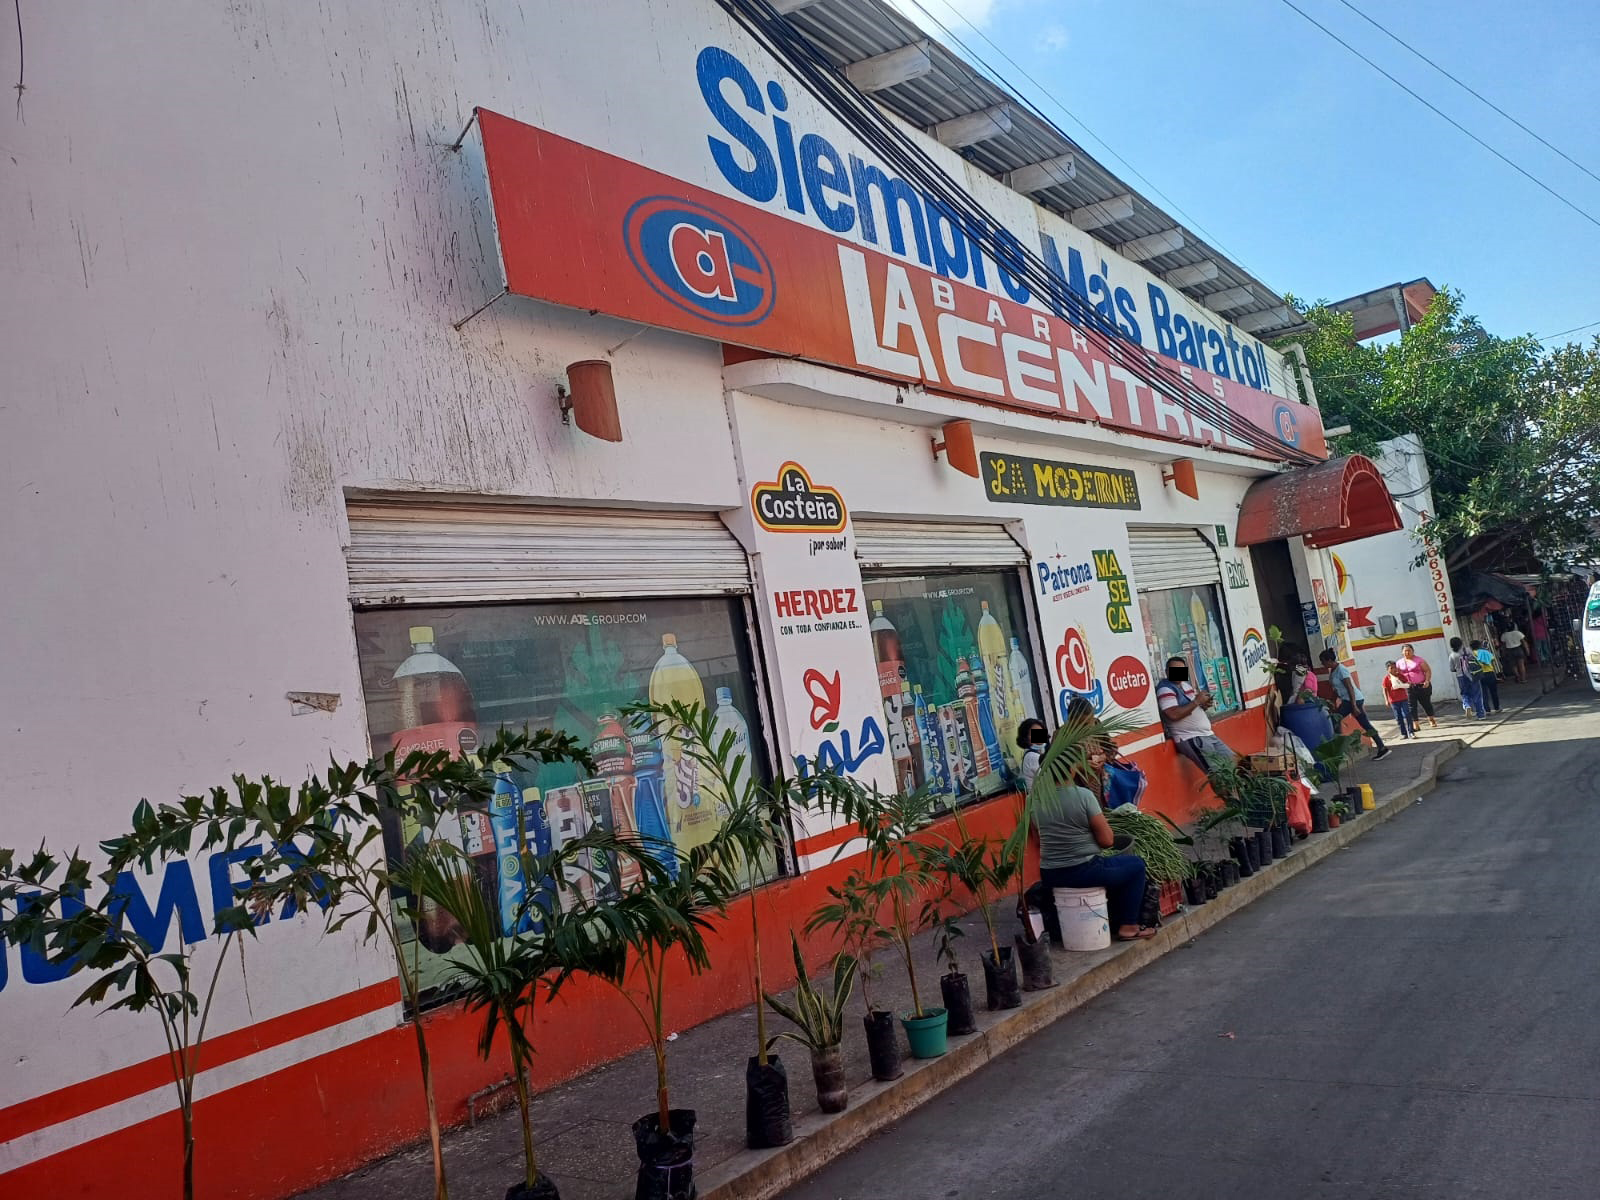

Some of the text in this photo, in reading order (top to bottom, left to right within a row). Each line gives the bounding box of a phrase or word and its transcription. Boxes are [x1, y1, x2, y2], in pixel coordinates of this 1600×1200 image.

[697, 46, 1031, 304] Siempre
[837, 243, 940, 384] LA
[786, 473, 805, 493] La
[761, 493, 838, 520] Costeña
[1036, 562, 1093, 595] Patrona
[1095, 553, 1122, 578] MA
[774, 588, 858, 620] HERDEZ
[1108, 579, 1130, 603] SE
[780, 625, 793, 635] CON
[814, 621, 847, 632] CONFIANZA
[1106, 605, 1132, 630] CA
[1109, 670, 1147, 692] Cuétara
[0, 808, 339, 994] UMEX
